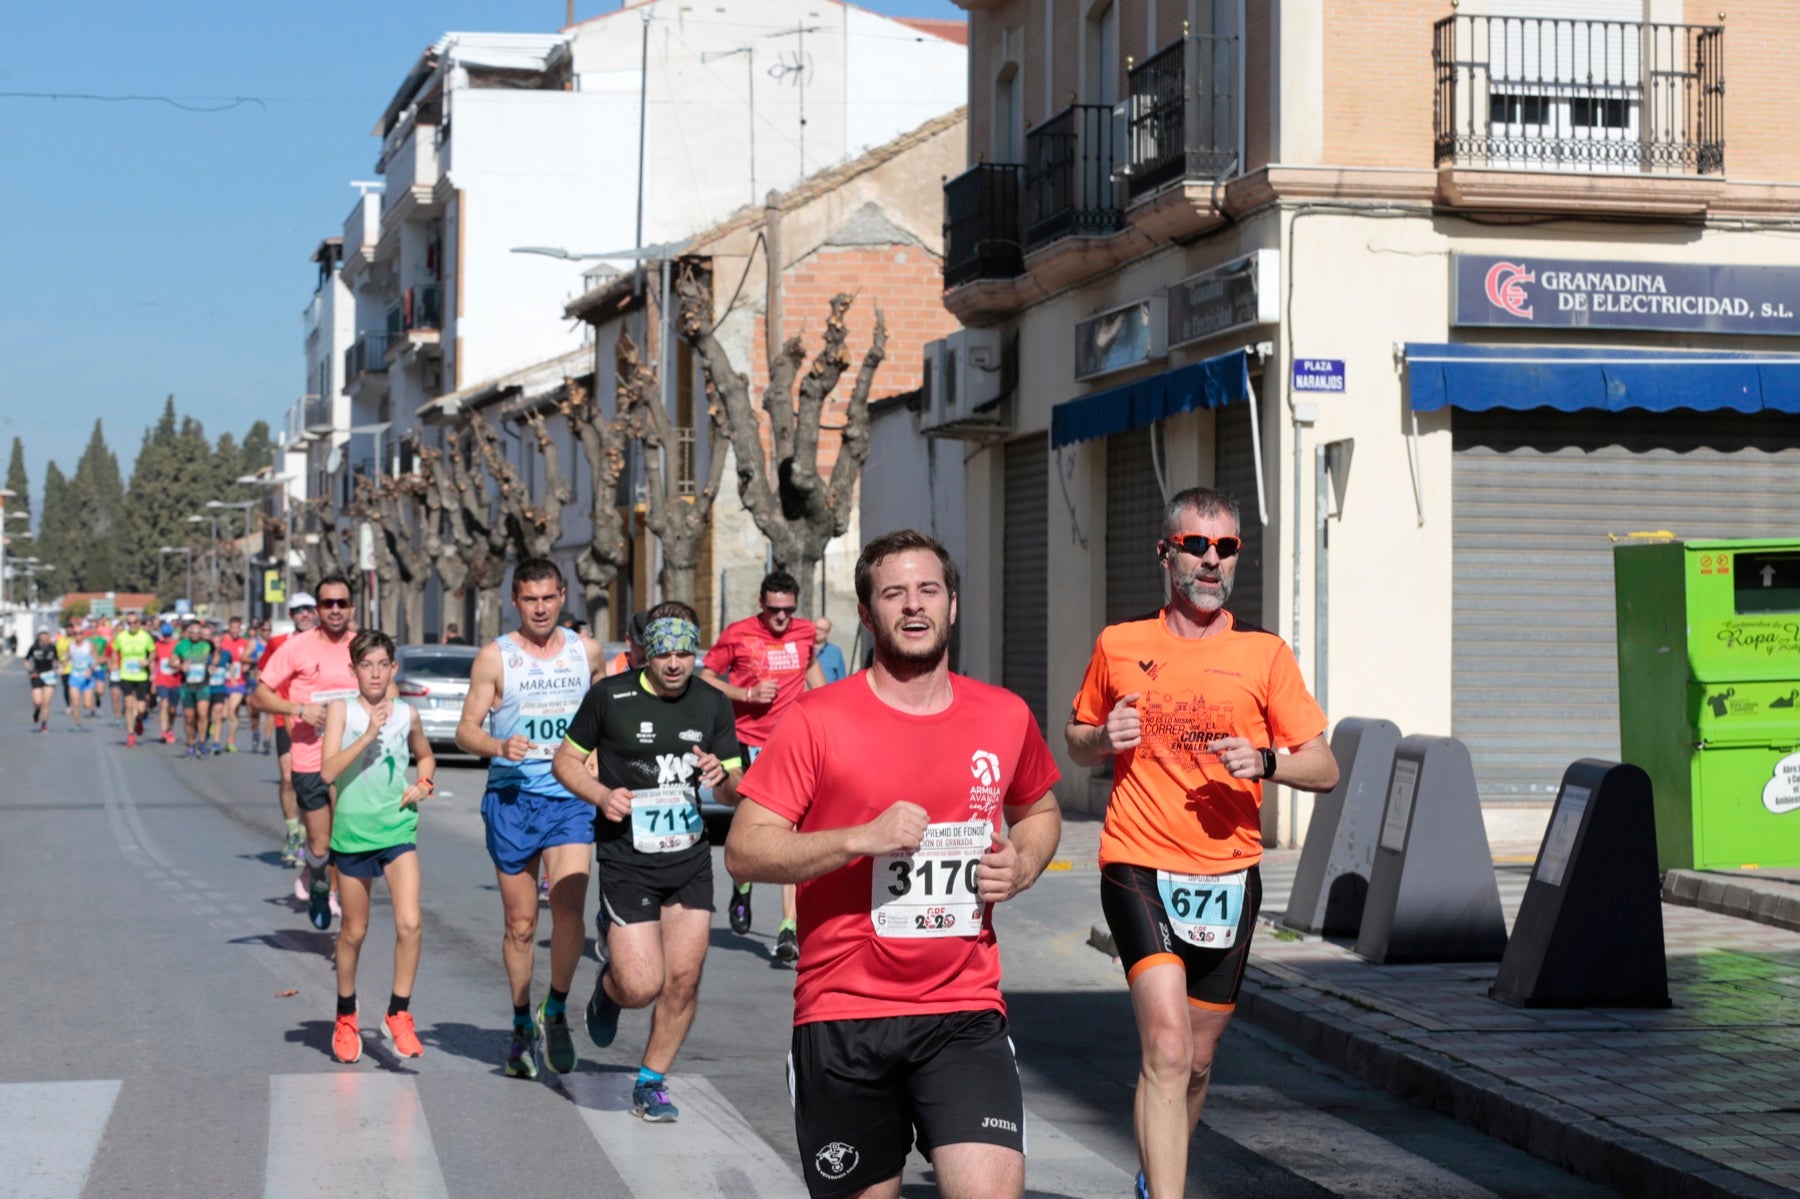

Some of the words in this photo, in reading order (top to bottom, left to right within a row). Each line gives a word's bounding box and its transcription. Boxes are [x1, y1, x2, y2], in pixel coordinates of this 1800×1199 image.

[1541, 271, 1668, 293] GRANADINA
[1558, 292, 1589, 312] DE
[1592, 293, 1754, 318] ELECTRICIDAD,
[1761, 302, 1794, 318] S.L.
[1304, 361, 1333, 371] PLAZA
[1296, 375, 1343, 390] NARANJOS
[1716, 628, 1777, 651] Ropa
[519, 676, 582, 692] MARACENA
[525, 718, 567, 740] 108
[1145, 723, 1185, 735] CORRER
[1171, 742, 1182, 750] EN
[969, 785, 1000, 795] ARMILLA
[969, 794, 999, 803] AVANZA
[645, 808, 690, 833] 711
[926, 828, 952, 839] PREMIO
[953, 827, 963, 838] DE
[963, 826, 985, 837] FONDO
[936, 839, 943, 847] DE
[945, 837, 974, 847] GRANADA
[888, 858, 978, 896] 3170
[1171, 887, 1228, 920] 671
